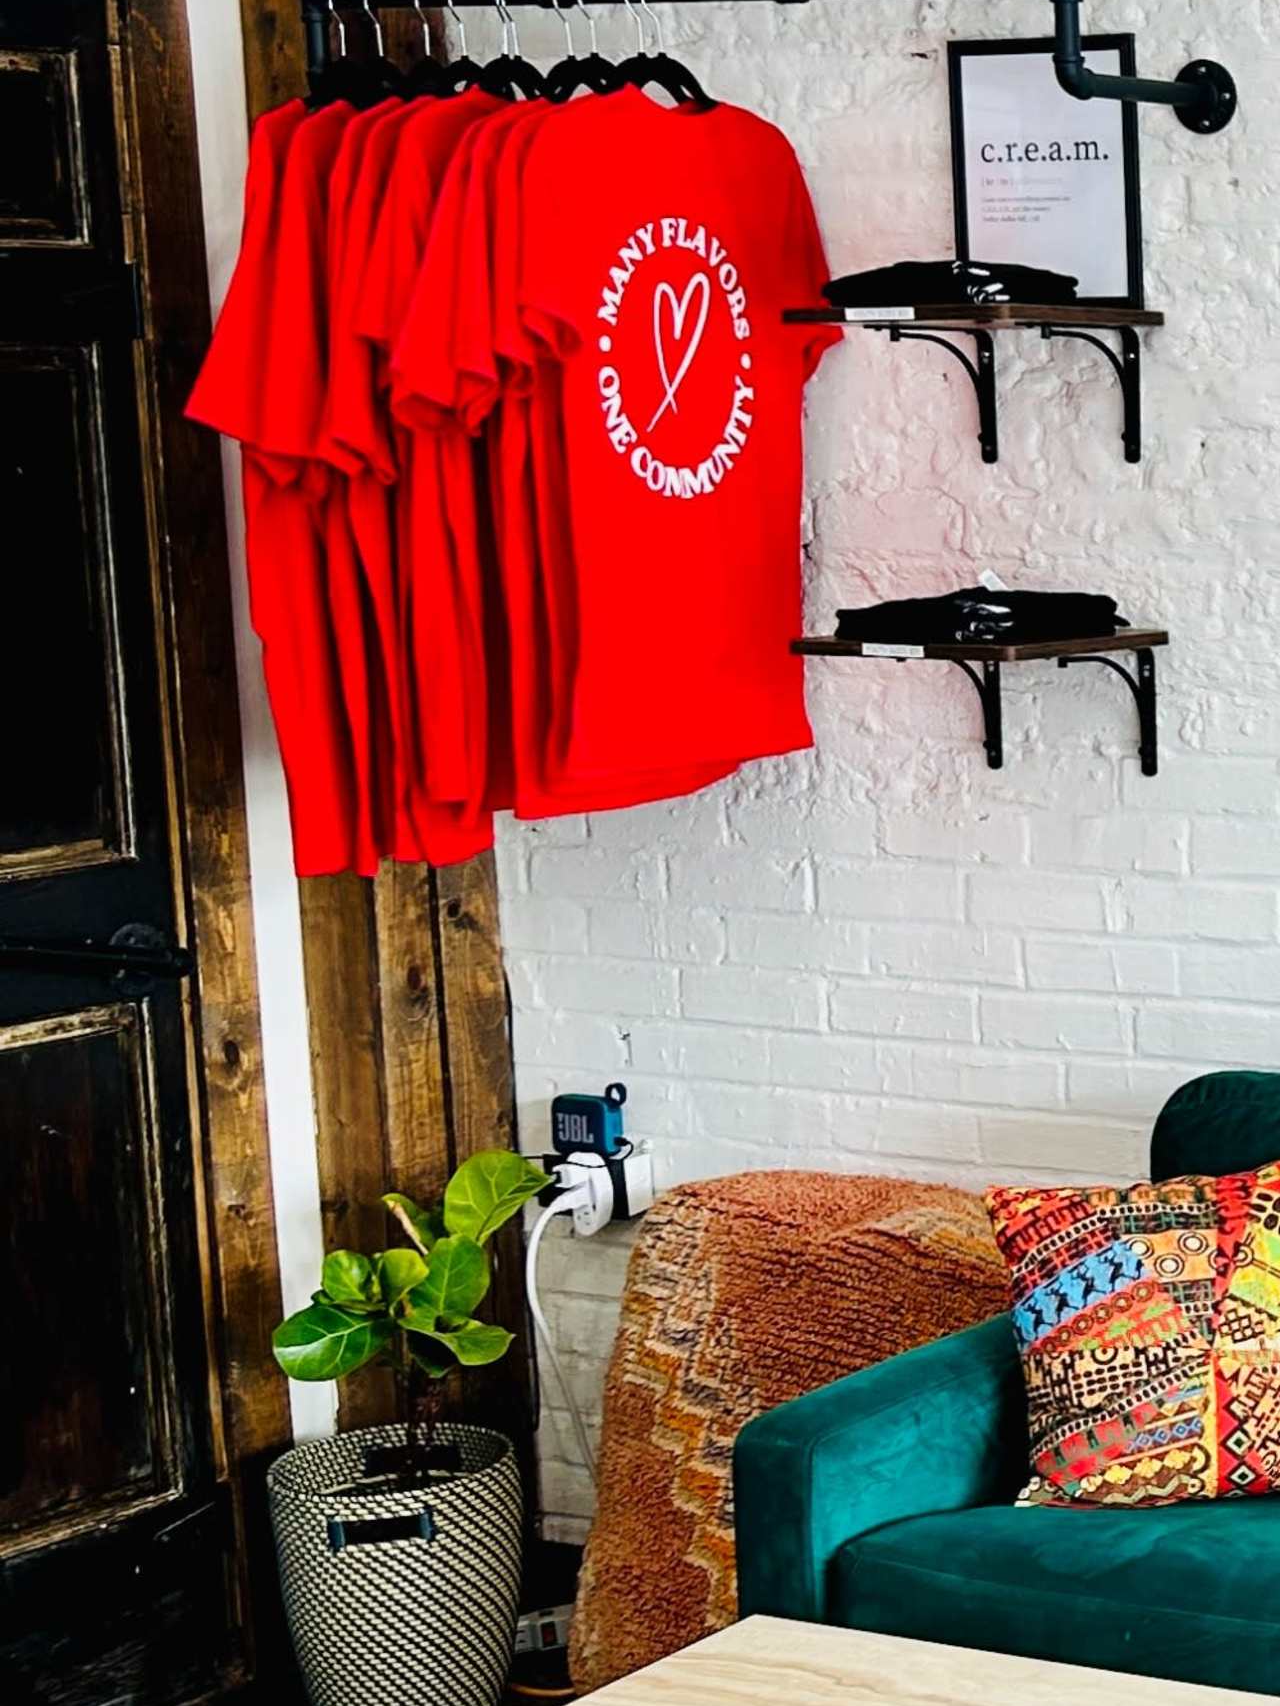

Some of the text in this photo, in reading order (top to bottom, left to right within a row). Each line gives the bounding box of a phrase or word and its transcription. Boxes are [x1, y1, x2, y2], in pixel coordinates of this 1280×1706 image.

[981, 141, 1109, 163] c.r.e.a.m.
[597, 217, 751, 340] MANY FLAVORS
[598, 366, 754, 499] ONE COMMUNITY
[556, 1113, 594, 1144] JBL
